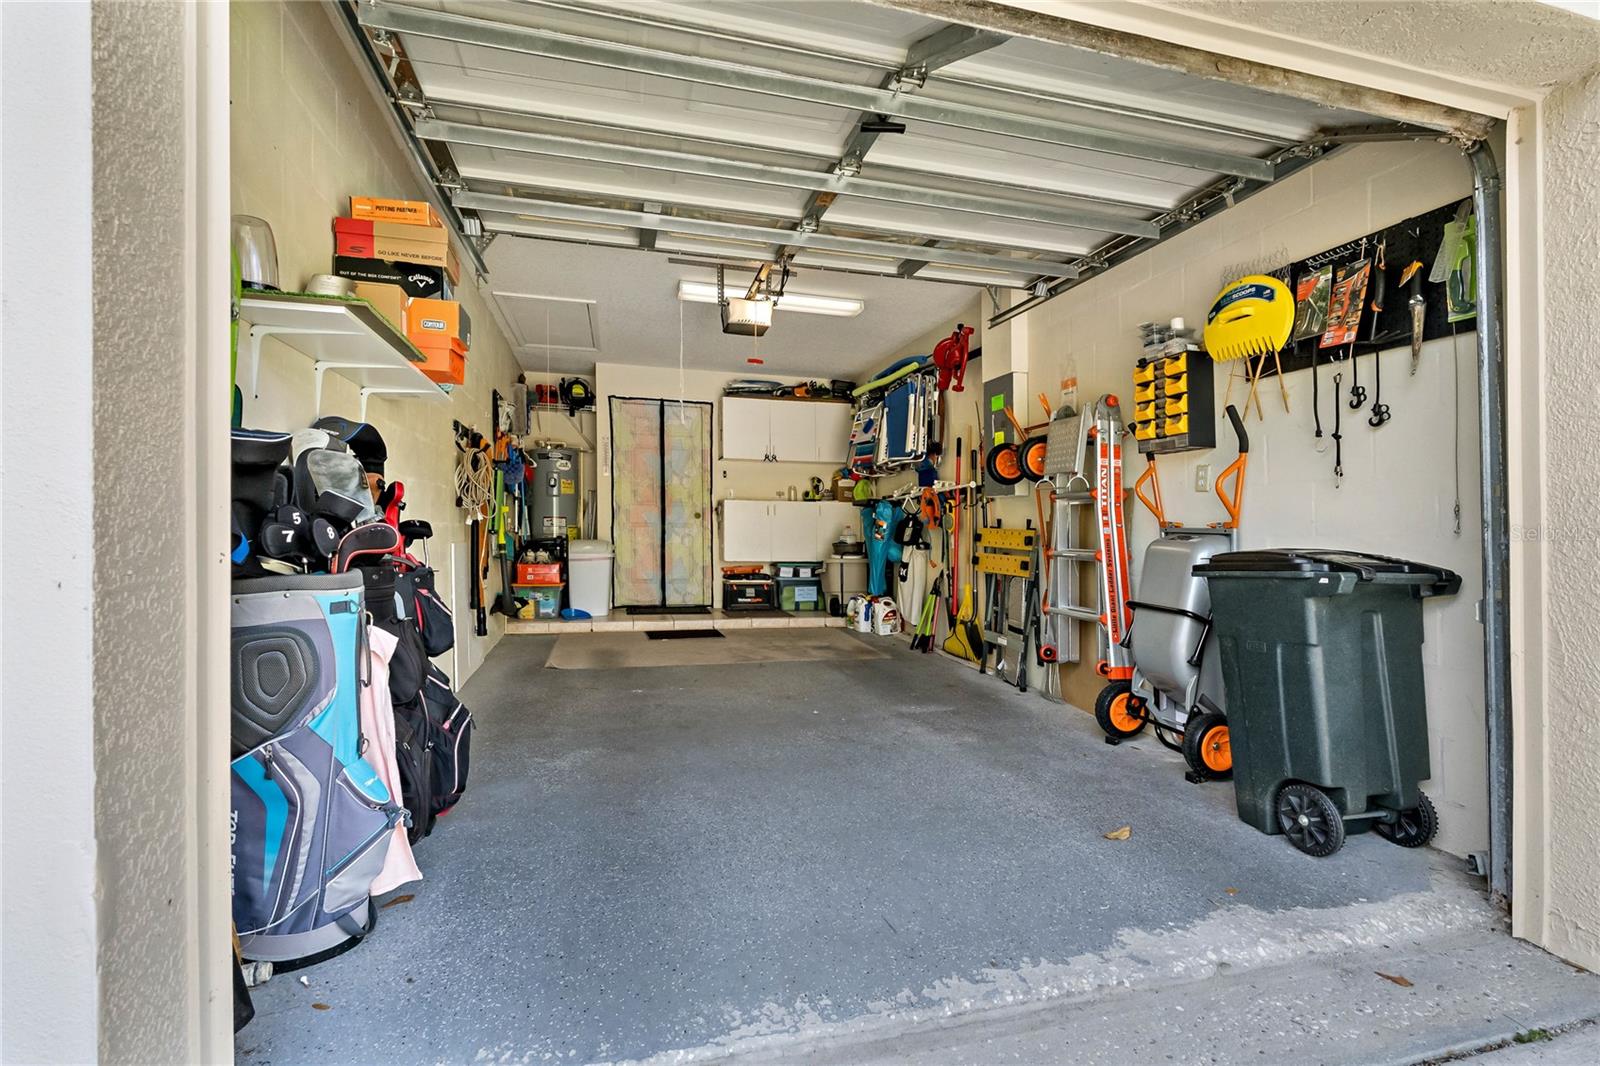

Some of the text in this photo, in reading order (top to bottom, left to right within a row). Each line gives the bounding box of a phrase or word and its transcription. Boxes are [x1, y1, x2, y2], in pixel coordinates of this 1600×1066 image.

[408, 273, 434, 284] Callaway
[292, 512, 301, 524] 5
[282, 530, 294, 542] 7
[327, 527, 335, 539] 8
